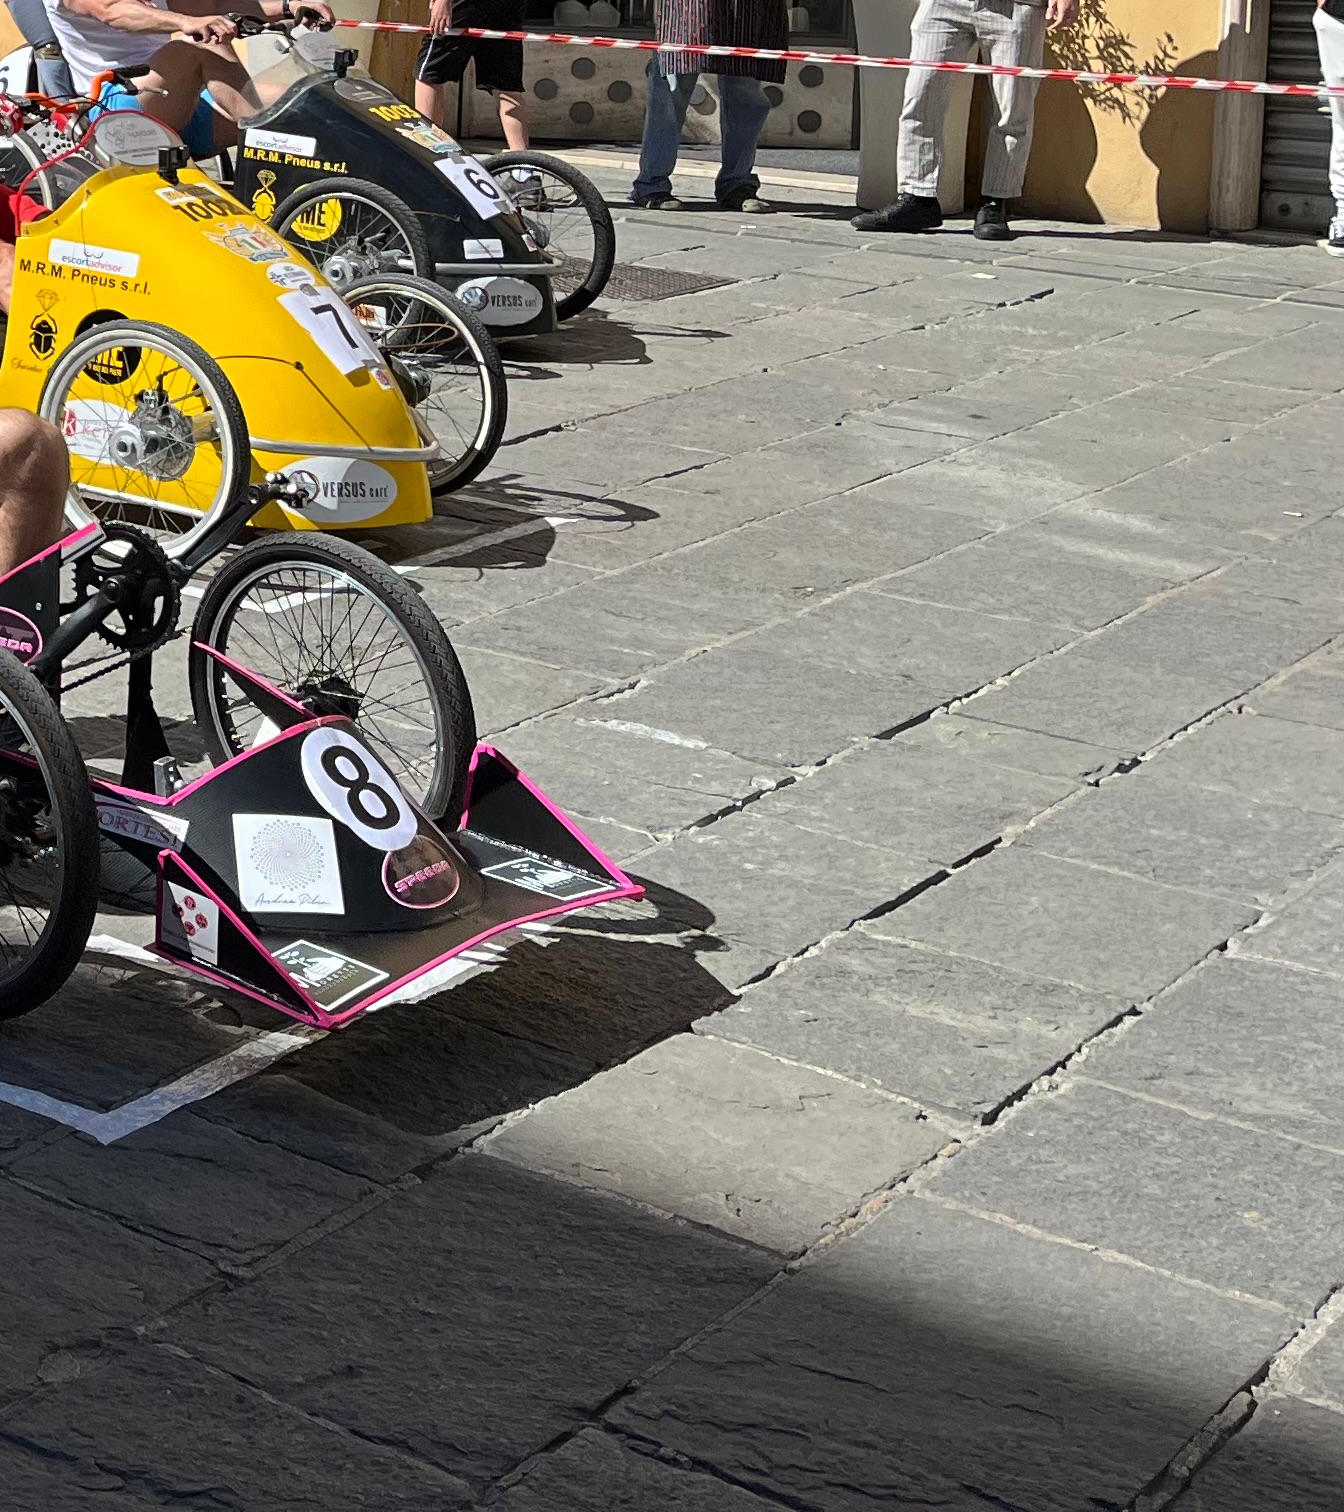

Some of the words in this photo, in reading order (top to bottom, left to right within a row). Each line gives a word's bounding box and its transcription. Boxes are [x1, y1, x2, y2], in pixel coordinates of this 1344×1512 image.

[369, 104, 422, 122] 1003
[244, 147, 282, 164] M.R.M.
[285, 153, 321, 169] Pneus
[323, 162, 349, 174] s.r.l.
[463, 168, 501, 200] 6
[19, 259, 67, 279] M.R.M.
[72, 269, 116, 289] Pneus
[121, 280, 151, 295] s.r.l.
[61, 254, 123, 273] escortadvisor
[491, 295, 524, 308] VERSUS
[310, 304, 359, 349] 7
[322, 482, 366, 498] VERSUS
[321, 744, 401, 831] 8
